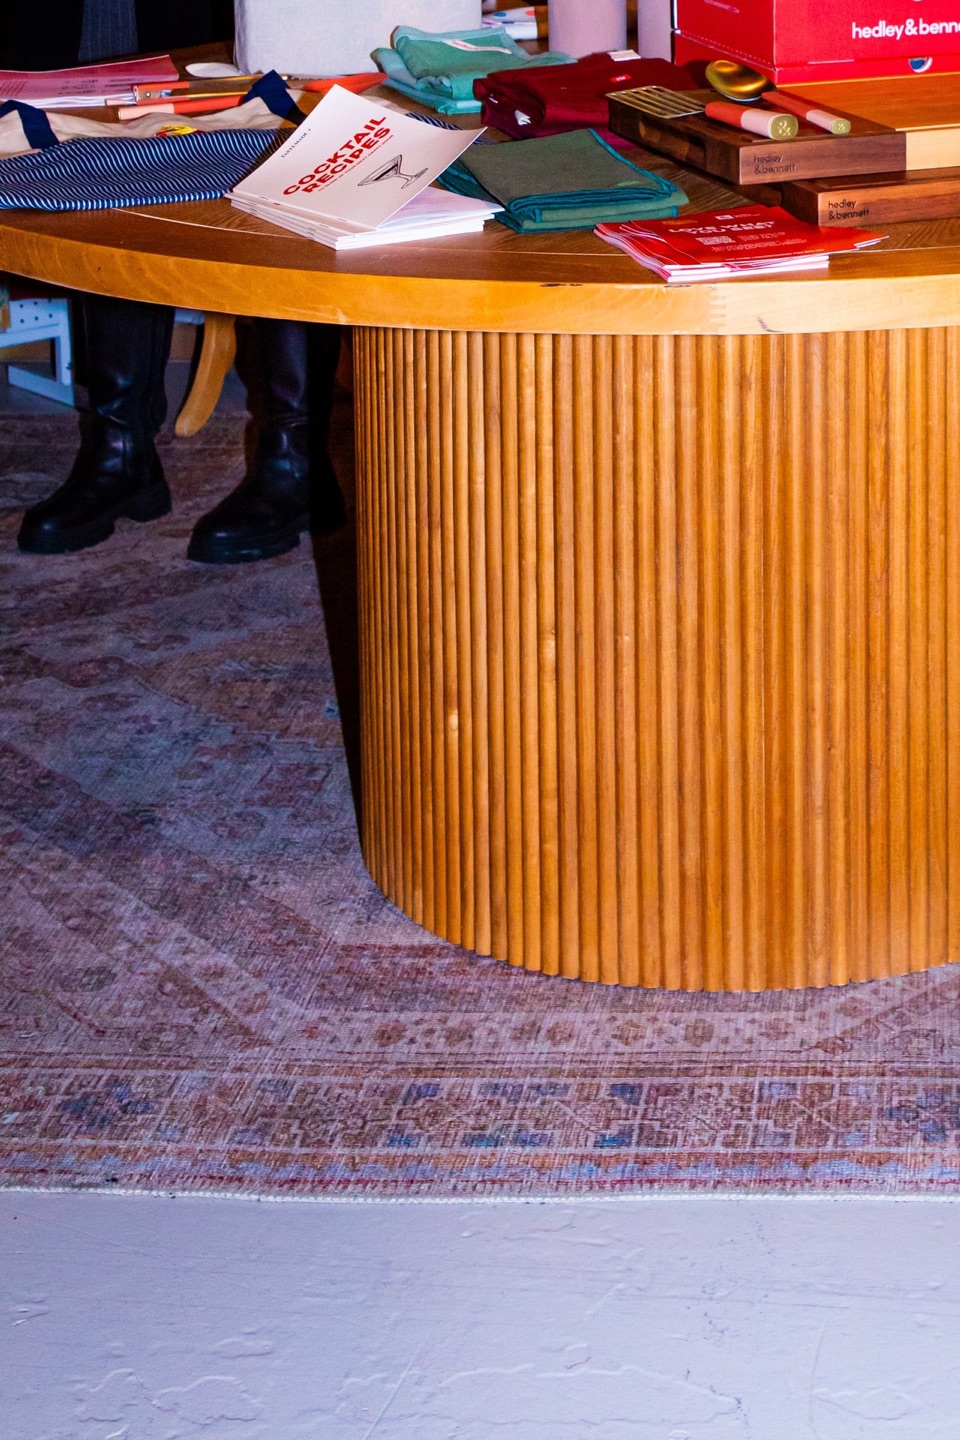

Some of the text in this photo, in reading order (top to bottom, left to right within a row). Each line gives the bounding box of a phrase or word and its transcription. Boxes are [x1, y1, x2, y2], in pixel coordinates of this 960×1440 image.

[283, 116, 387, 195] COCKTAIL
[301, 127, 391, 193] RECIPES
[753, 154, 784, 164] hedley
[828, 199, 857, 209] hedley
